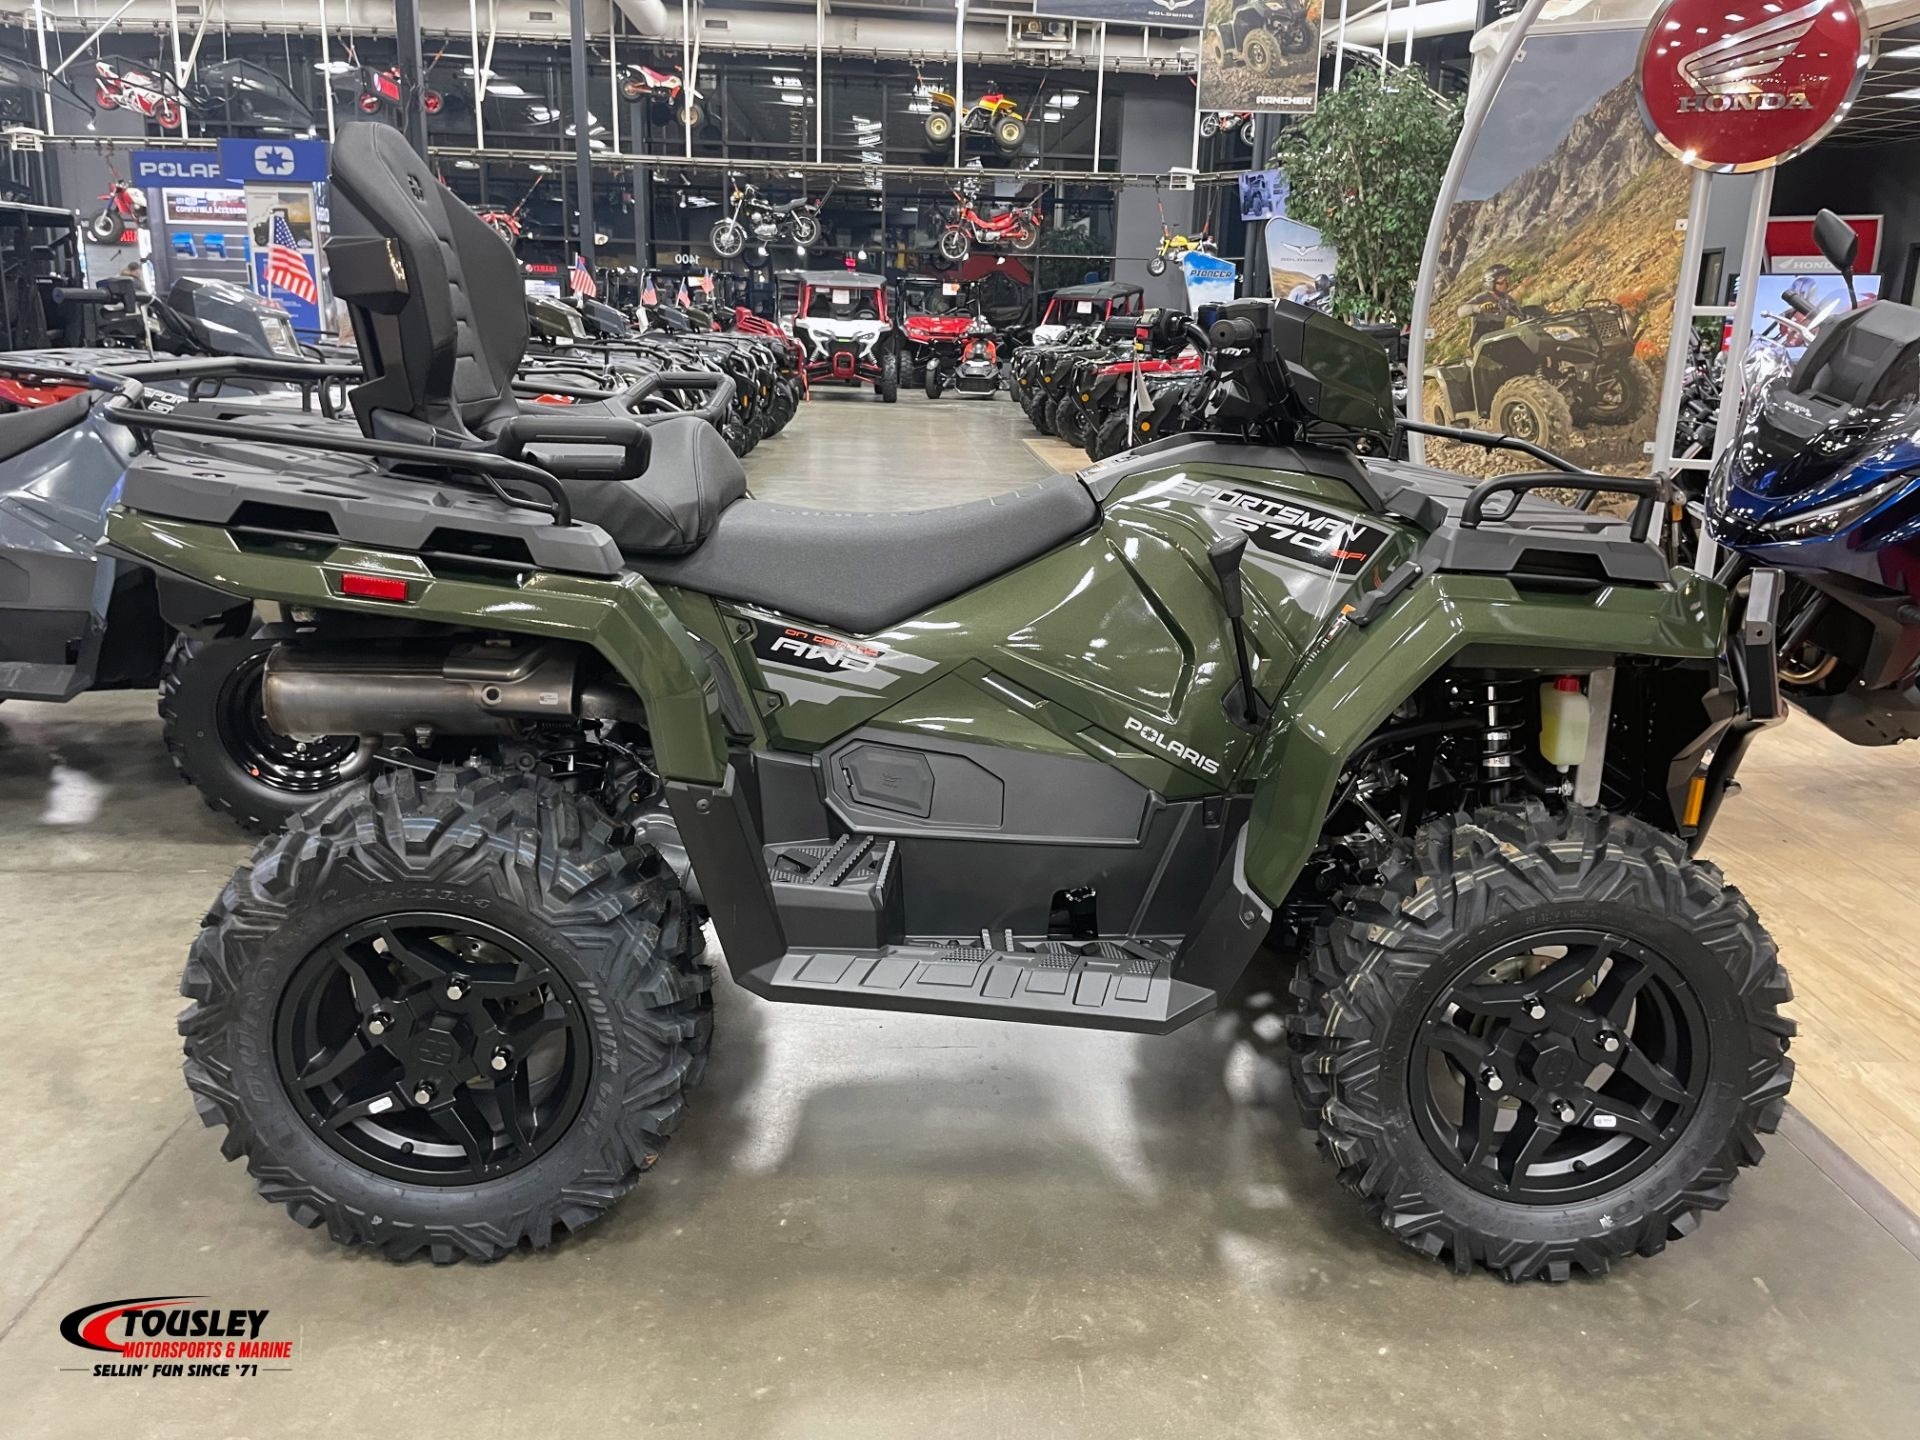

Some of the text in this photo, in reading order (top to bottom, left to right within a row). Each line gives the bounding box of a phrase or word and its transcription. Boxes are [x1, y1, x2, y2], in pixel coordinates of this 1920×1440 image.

[1256, 96, 1312, 105] RANCHER
[1677, 92, 1814, 112] HONDA
[1190, 269, 1232, 278] PIONEER
[1174, 479, 1367, 542] SPORTSMAN
[1220, 513, 1333, 552] 570
[770, 636, 877, 672] AWD
[1124, 716, 1220, 775] POLARIS
